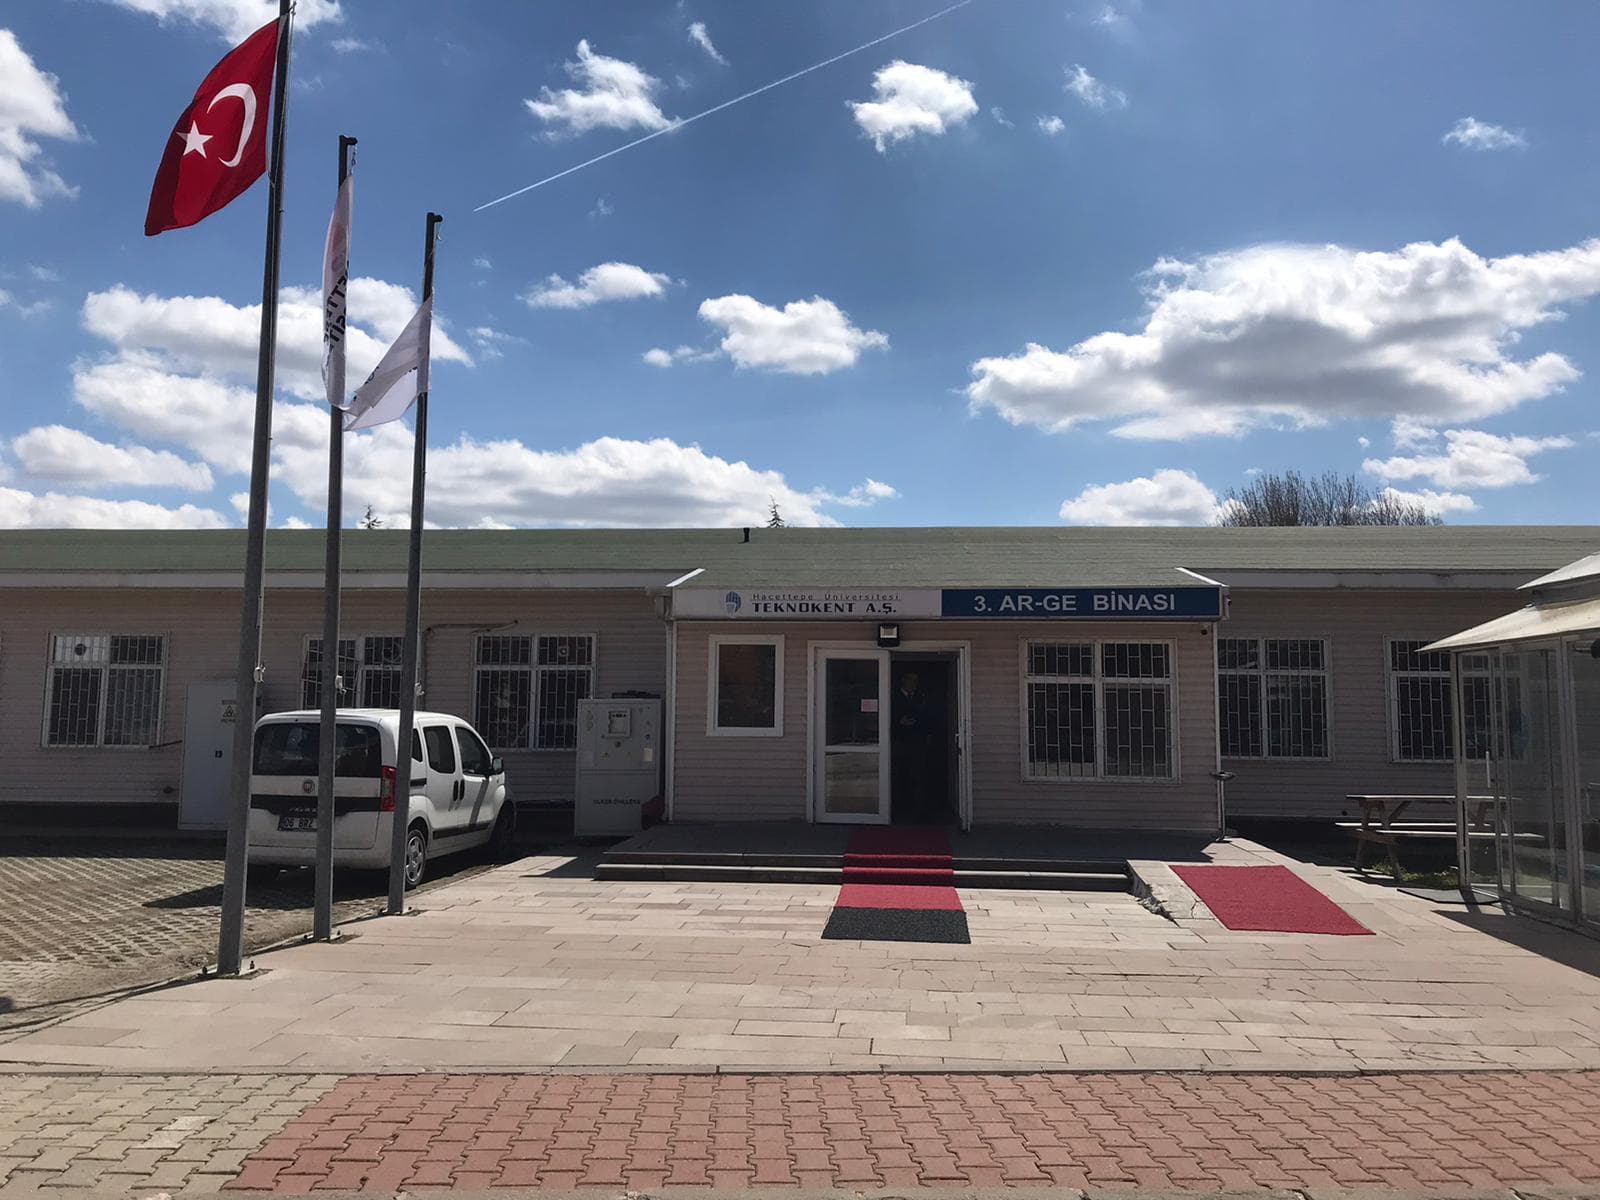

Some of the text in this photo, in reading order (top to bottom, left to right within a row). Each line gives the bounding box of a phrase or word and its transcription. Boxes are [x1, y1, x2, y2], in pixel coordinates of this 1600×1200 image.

[752, 592, 900, 602] Hacettepe Üniversitesi
[973, 591, 1176, 612] 3. AR-GE BİNASI
[752, 602, 897, 615] TEKNOKENT A.Ş.
